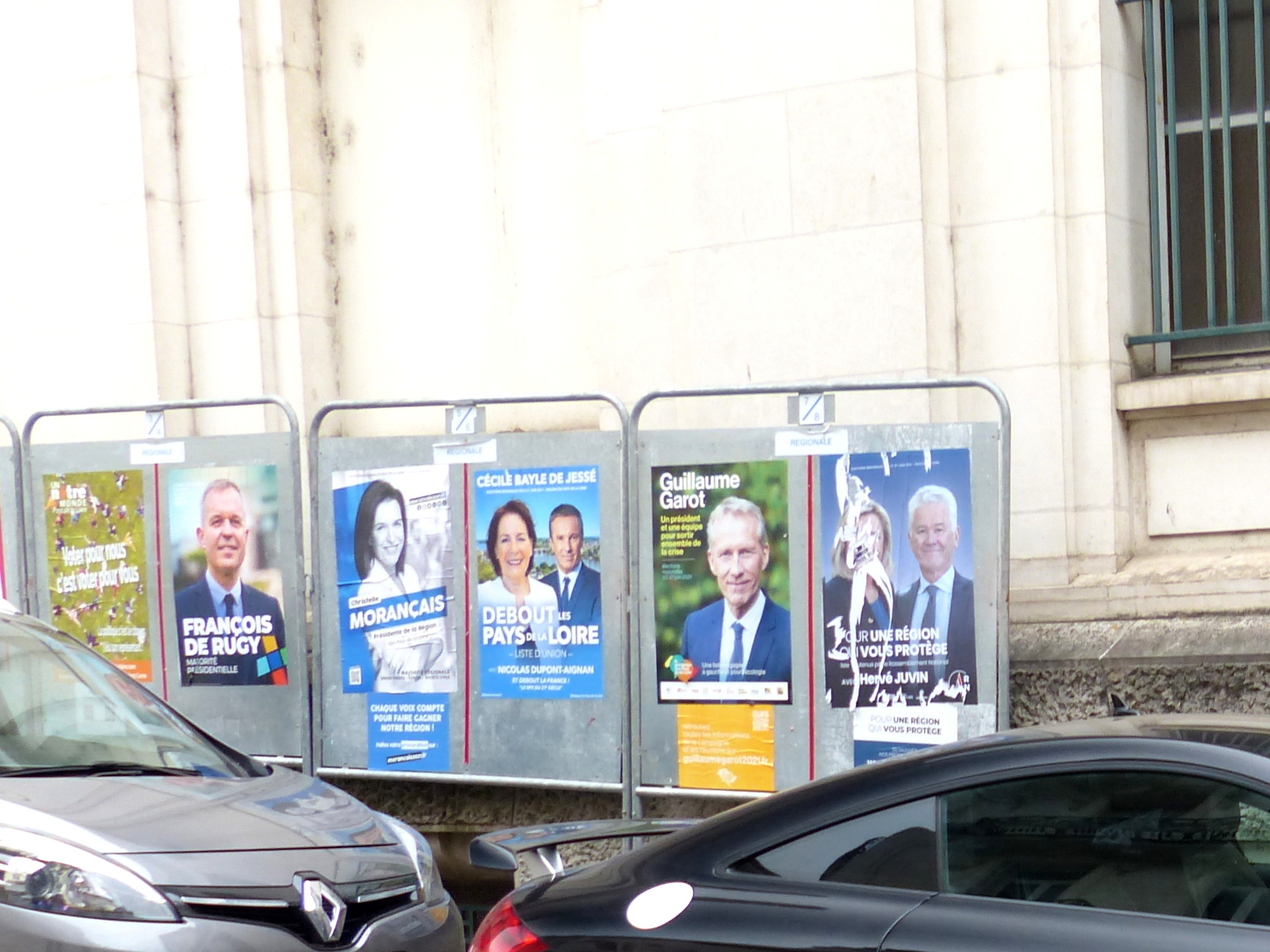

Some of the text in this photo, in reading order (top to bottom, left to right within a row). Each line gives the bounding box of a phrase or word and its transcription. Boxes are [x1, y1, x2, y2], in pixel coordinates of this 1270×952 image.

[476, 468, 596, 488] CÉCILE BAYLE DE JESSÉ
[660, 472, 740, 490] Guillaume
[660, 490, 706, 509] Garot
[670, 514, 700, 524] président
[681, 523, 703, 532] équipe
[661, 540, 692, 548] ensemble
[351, 596, 379, 607] Christelle
[350, 594, 445, 630] MORANÇAIS
[482, 606, 571, 624] DEBOUT LES
[183, 615, 273, 636] FRANÇOIS
[483, 625, 599, 645] PAYS DE LA LOIRE
[870, 630, 893, 641] UNE
[895, 626, 940, 640] RÉGION
[184, 636, 261, 656] DE RUGY
[860, 644, 893, 657] VOUS
[896, 640, 948, 656] PROTÈGE
[515, 649, 567, 658] LISTE D'UNION
[498, 666, 530, 674] NICOLAS
[531, 665, 594, 674] DUPONT-AIGNAN
[860, 671, 892, 685] Hervé
[894, 671, 928, 684] JUVIN
[370, 704, 397, 713] CHAQUE
[404, 722, 430, 732] RÉGION
[911, 715, 940, 725] RÉGION
